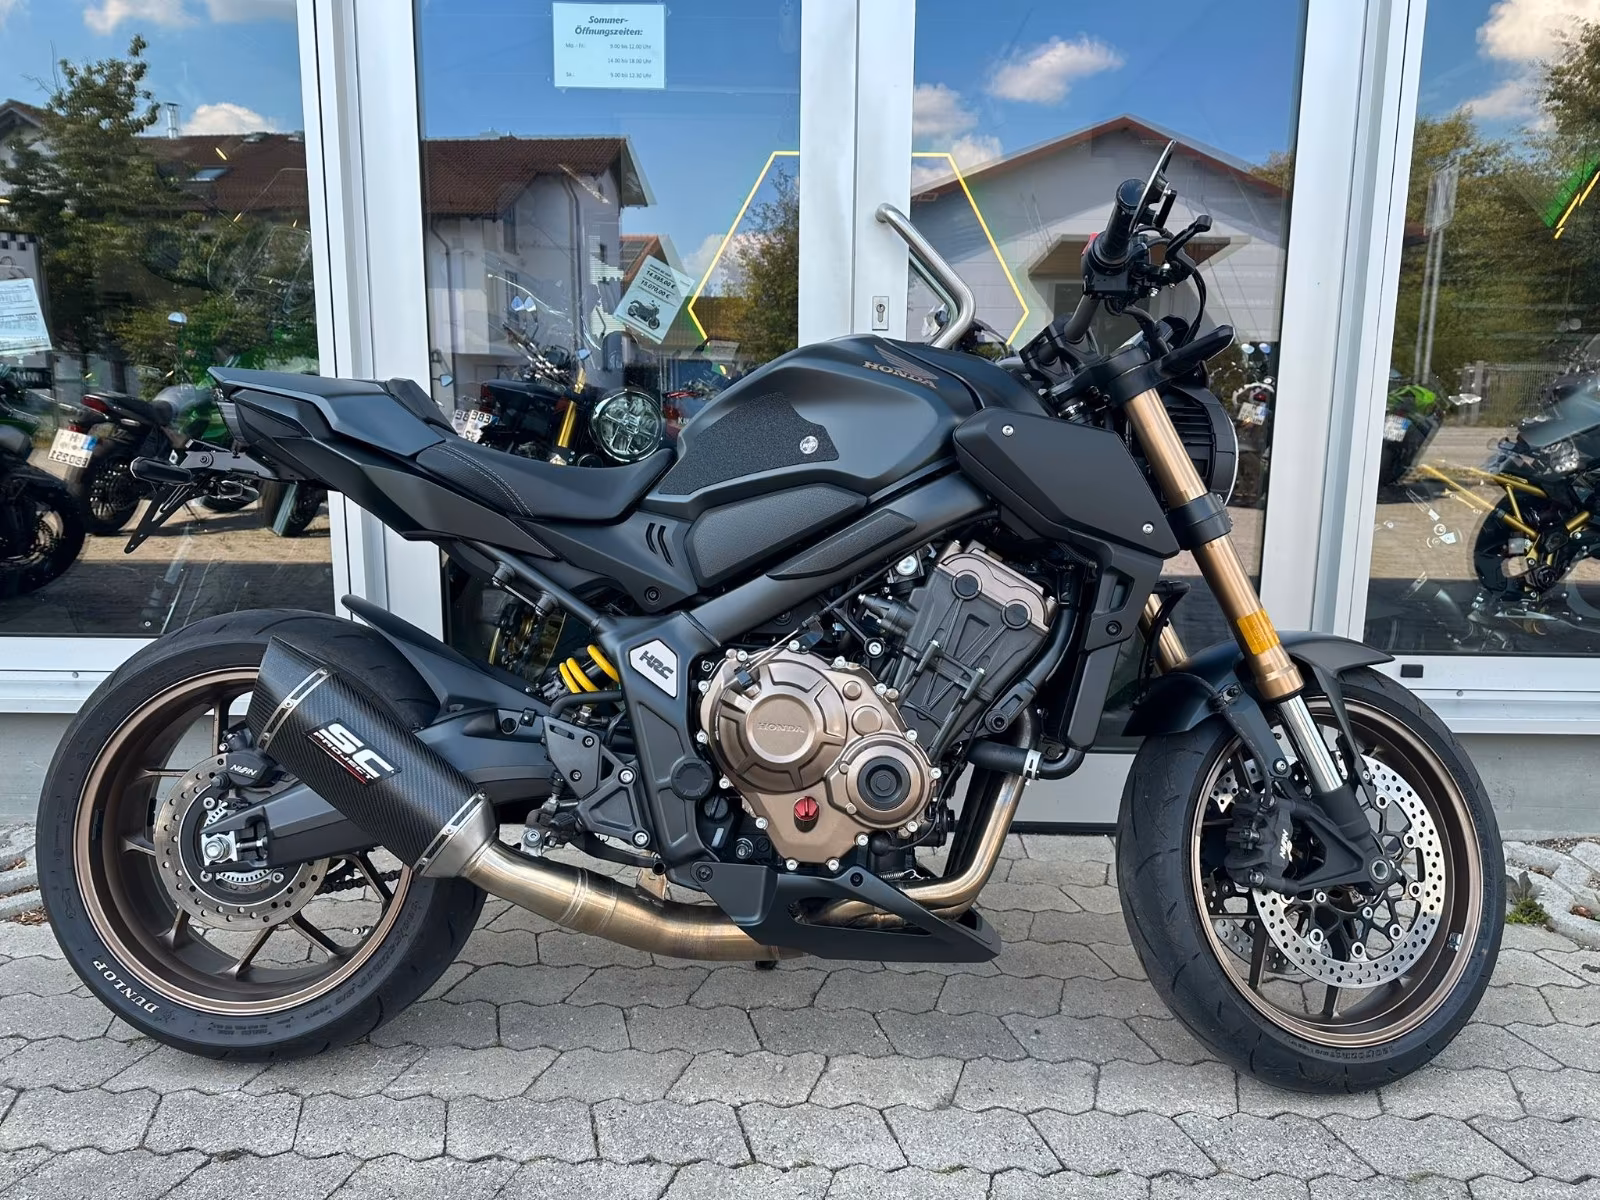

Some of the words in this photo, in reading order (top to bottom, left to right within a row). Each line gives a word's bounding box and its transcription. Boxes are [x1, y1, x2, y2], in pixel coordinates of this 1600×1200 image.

[574, 25, 643, 37] Öffnungszeiten:
[588, 15, 629, 24] Sommer-
[862, 360, 937, 389] HONDA
[639, 650, 674, 680] HRC
[757, 722, 805, 733] HONDA
[313, 731, 374, 780] PROJECT
[319, 723, 395, 778] SC
[93, 960, 160, 1013] DUNLOP
